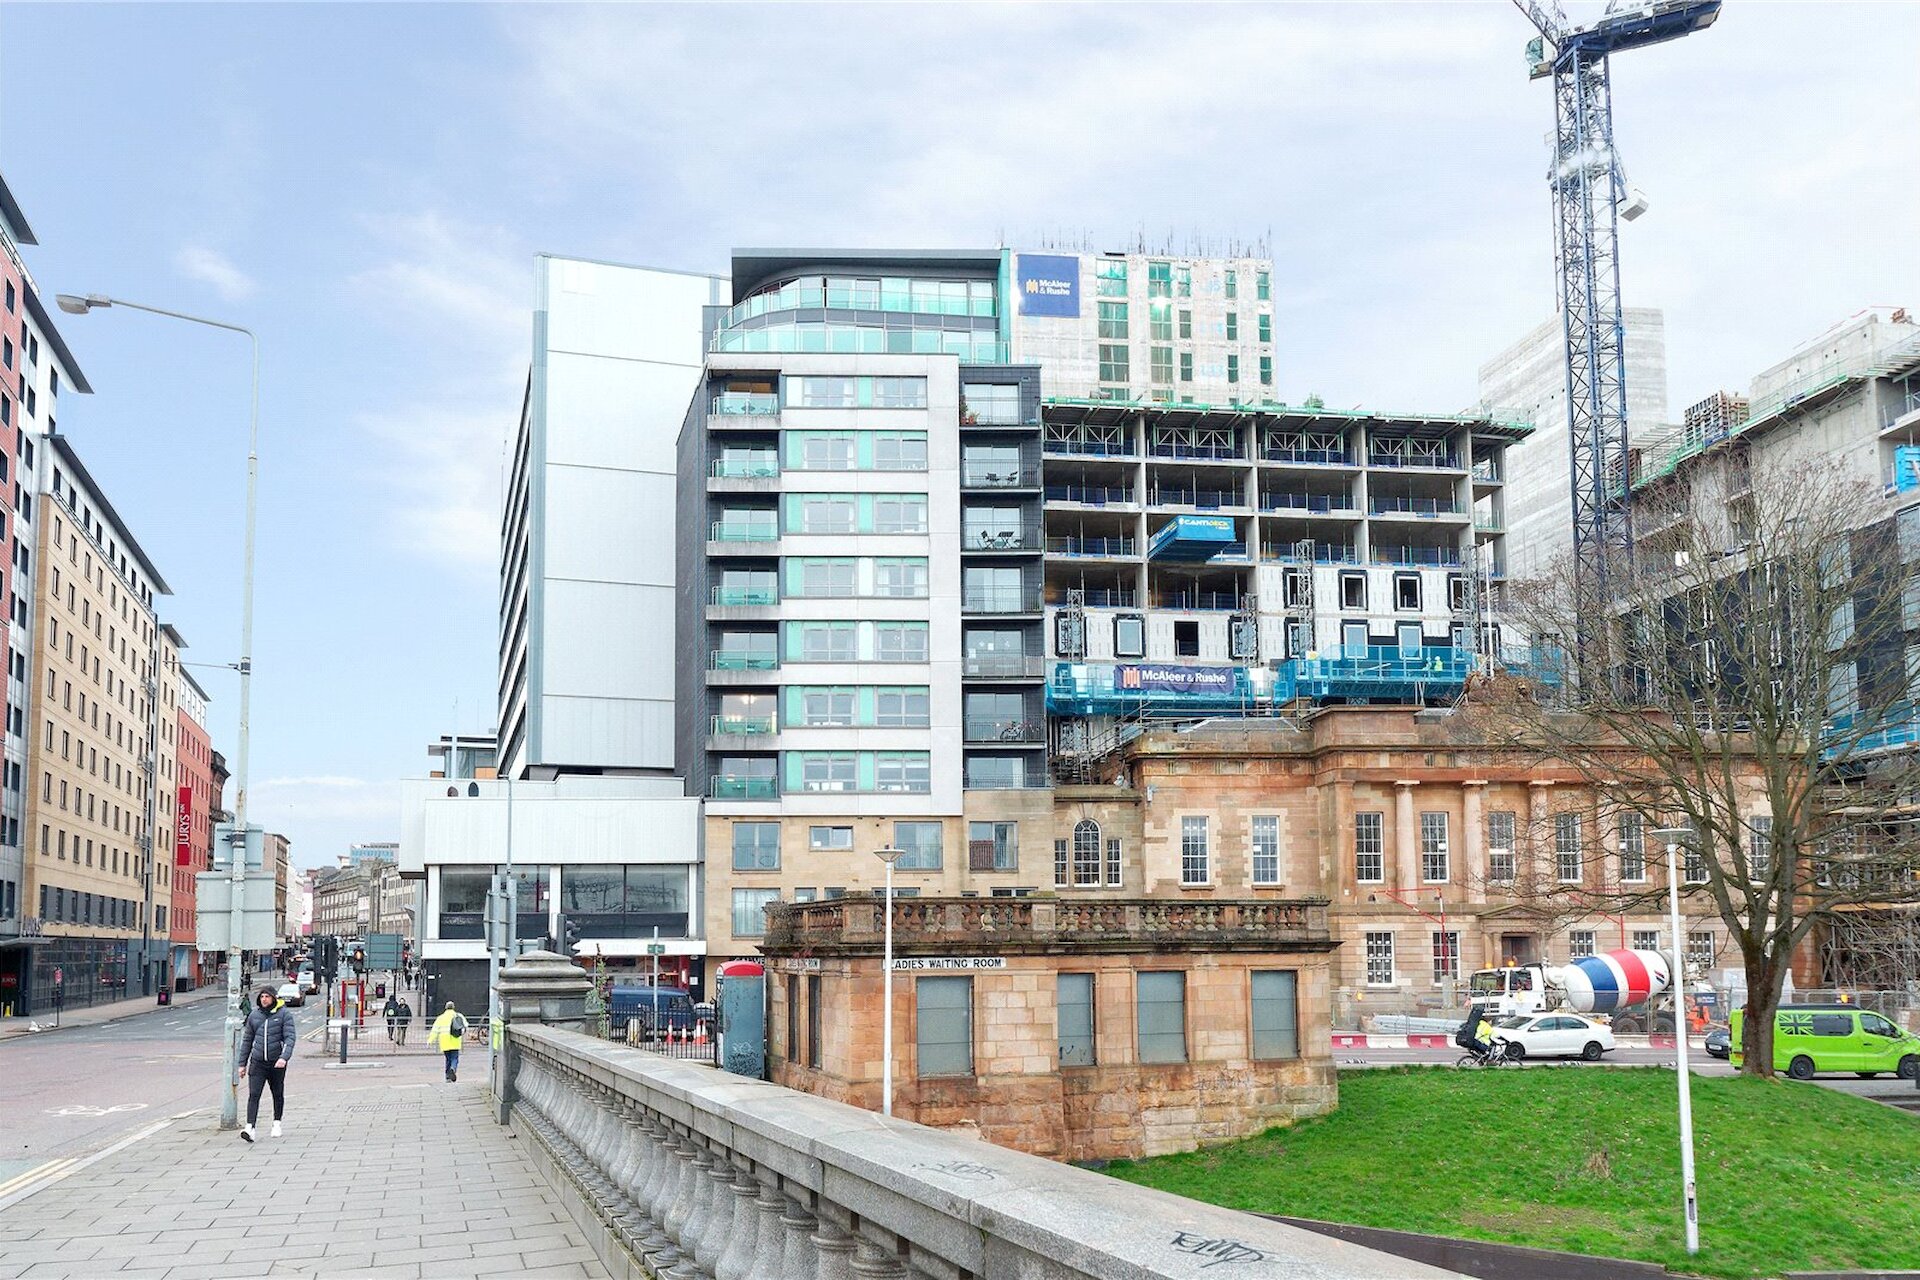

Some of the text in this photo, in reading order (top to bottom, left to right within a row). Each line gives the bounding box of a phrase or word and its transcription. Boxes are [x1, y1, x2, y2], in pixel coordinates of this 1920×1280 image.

[1039, 279, 1071, 288] McAleer
[1142, 670, 1227, 683] McAleer & Rushe
[178, 814, 190, 848] JURYS
[891, 958, 1001, 969] ADIES WAITING ROOM
